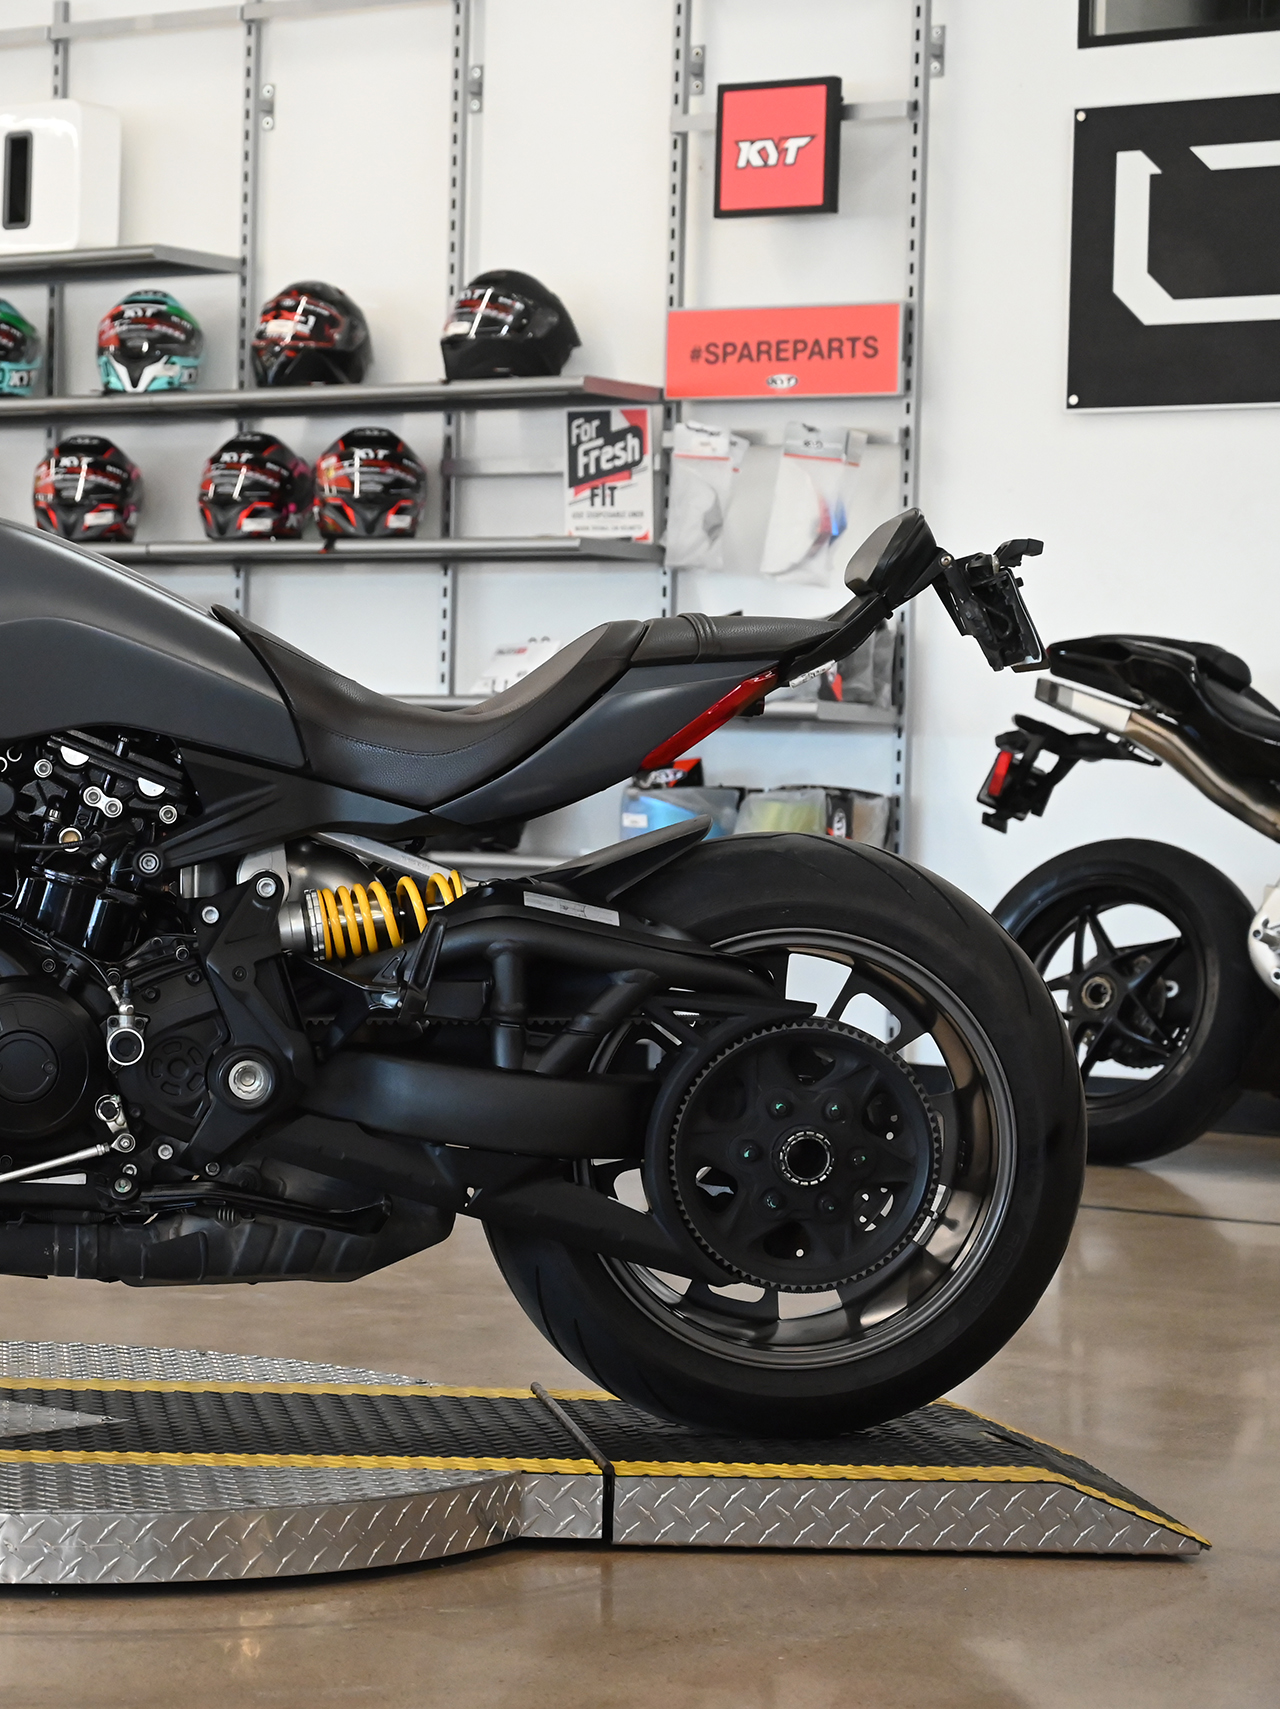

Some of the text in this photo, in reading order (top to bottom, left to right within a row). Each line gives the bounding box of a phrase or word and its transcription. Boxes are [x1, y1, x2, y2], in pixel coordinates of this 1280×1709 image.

[735, 135, 817, 169] KYT
[689, 336, 880, 365] #SPAREPARTS
[571, 417, 600, 446] For
[577, 433, 641, 479] Fresh
[590, 483, 618, 507] FIT
